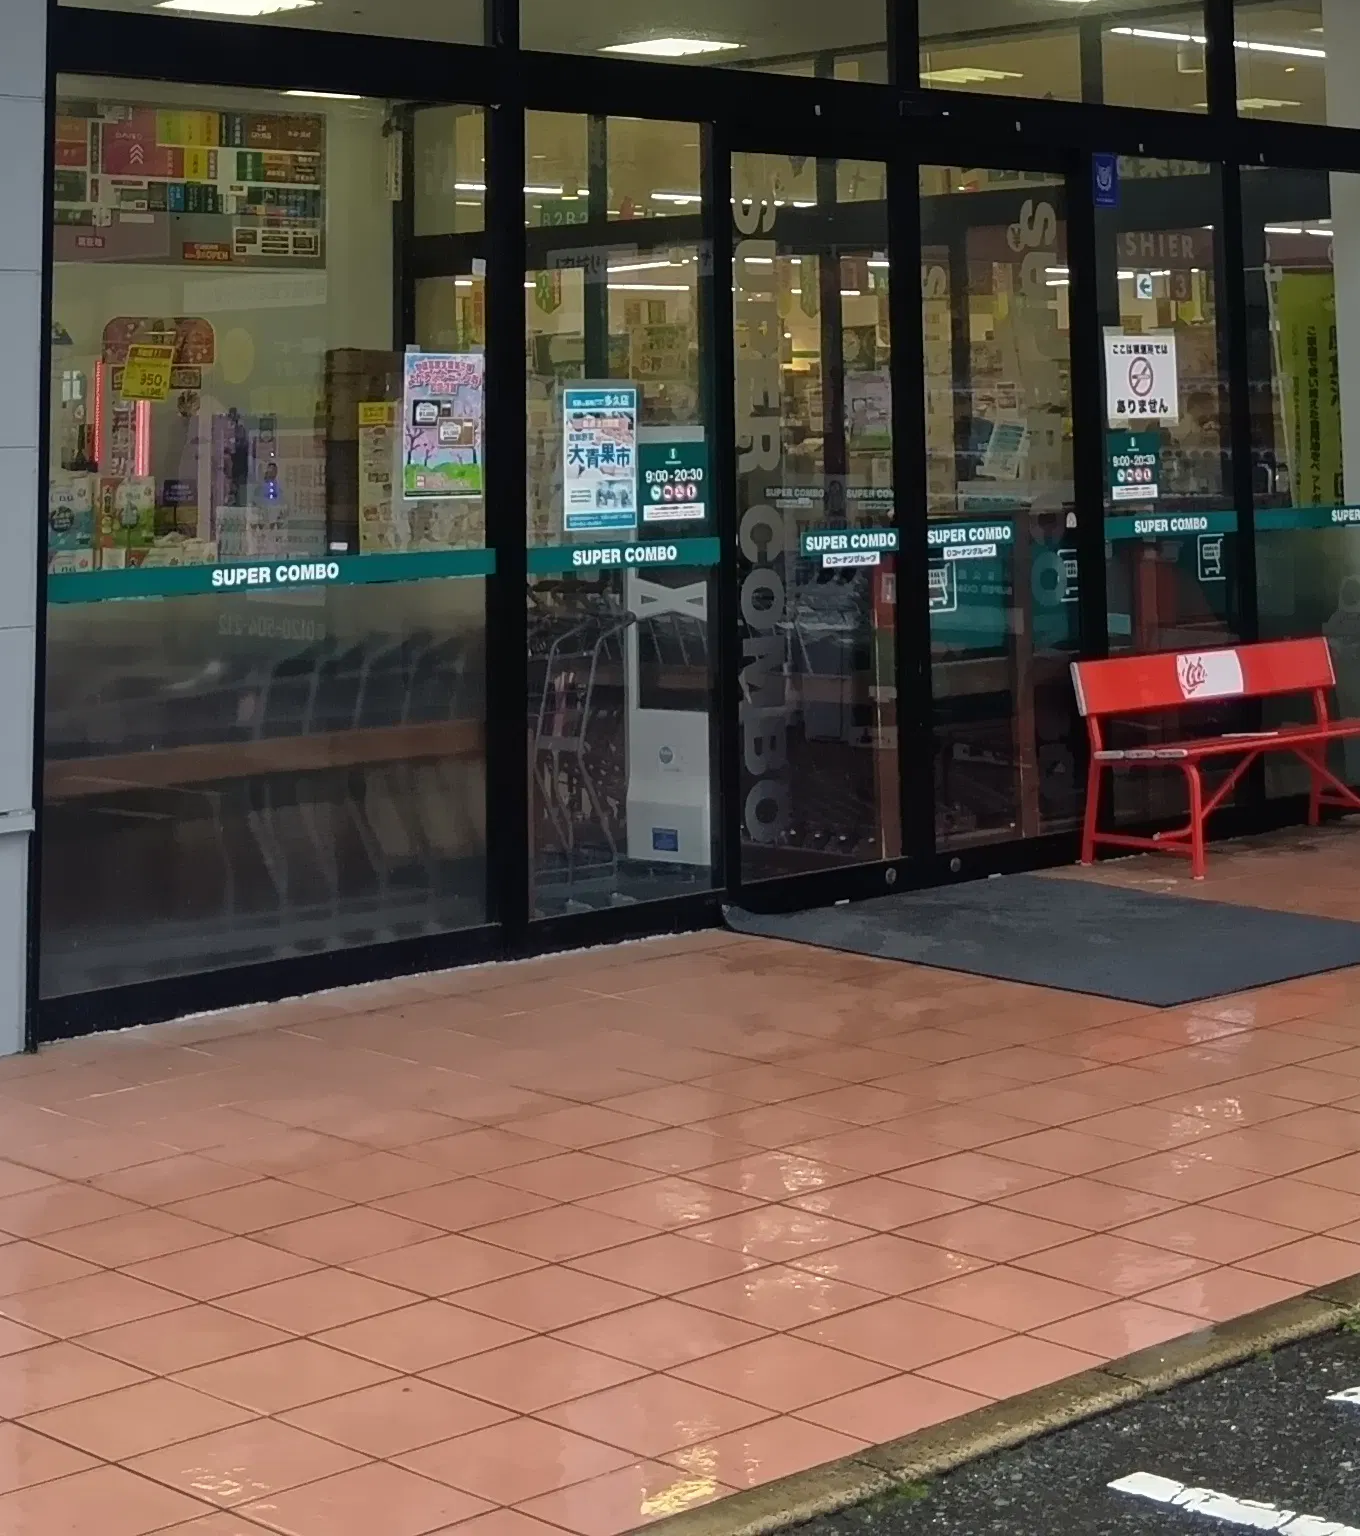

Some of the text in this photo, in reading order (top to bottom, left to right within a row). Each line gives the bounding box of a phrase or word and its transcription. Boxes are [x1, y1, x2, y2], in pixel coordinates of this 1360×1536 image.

[1117, 232, 1195, 258] SHIER
[1116, 399, 1169, 415] ありません
[568, 443, 632, 470] 大青果市
[1330, 508, 1360, 522] SUPER
[926, 525, 1011, 544] SUPER COMBO
[1134, 516, 1208, 534] SUPER COMBO
[805, 532, 897, 551] SUPER COMBO
[572, 545, 677, 566] SUPER COMBO
[211, 562, 340, 588] SUPER COMBO
